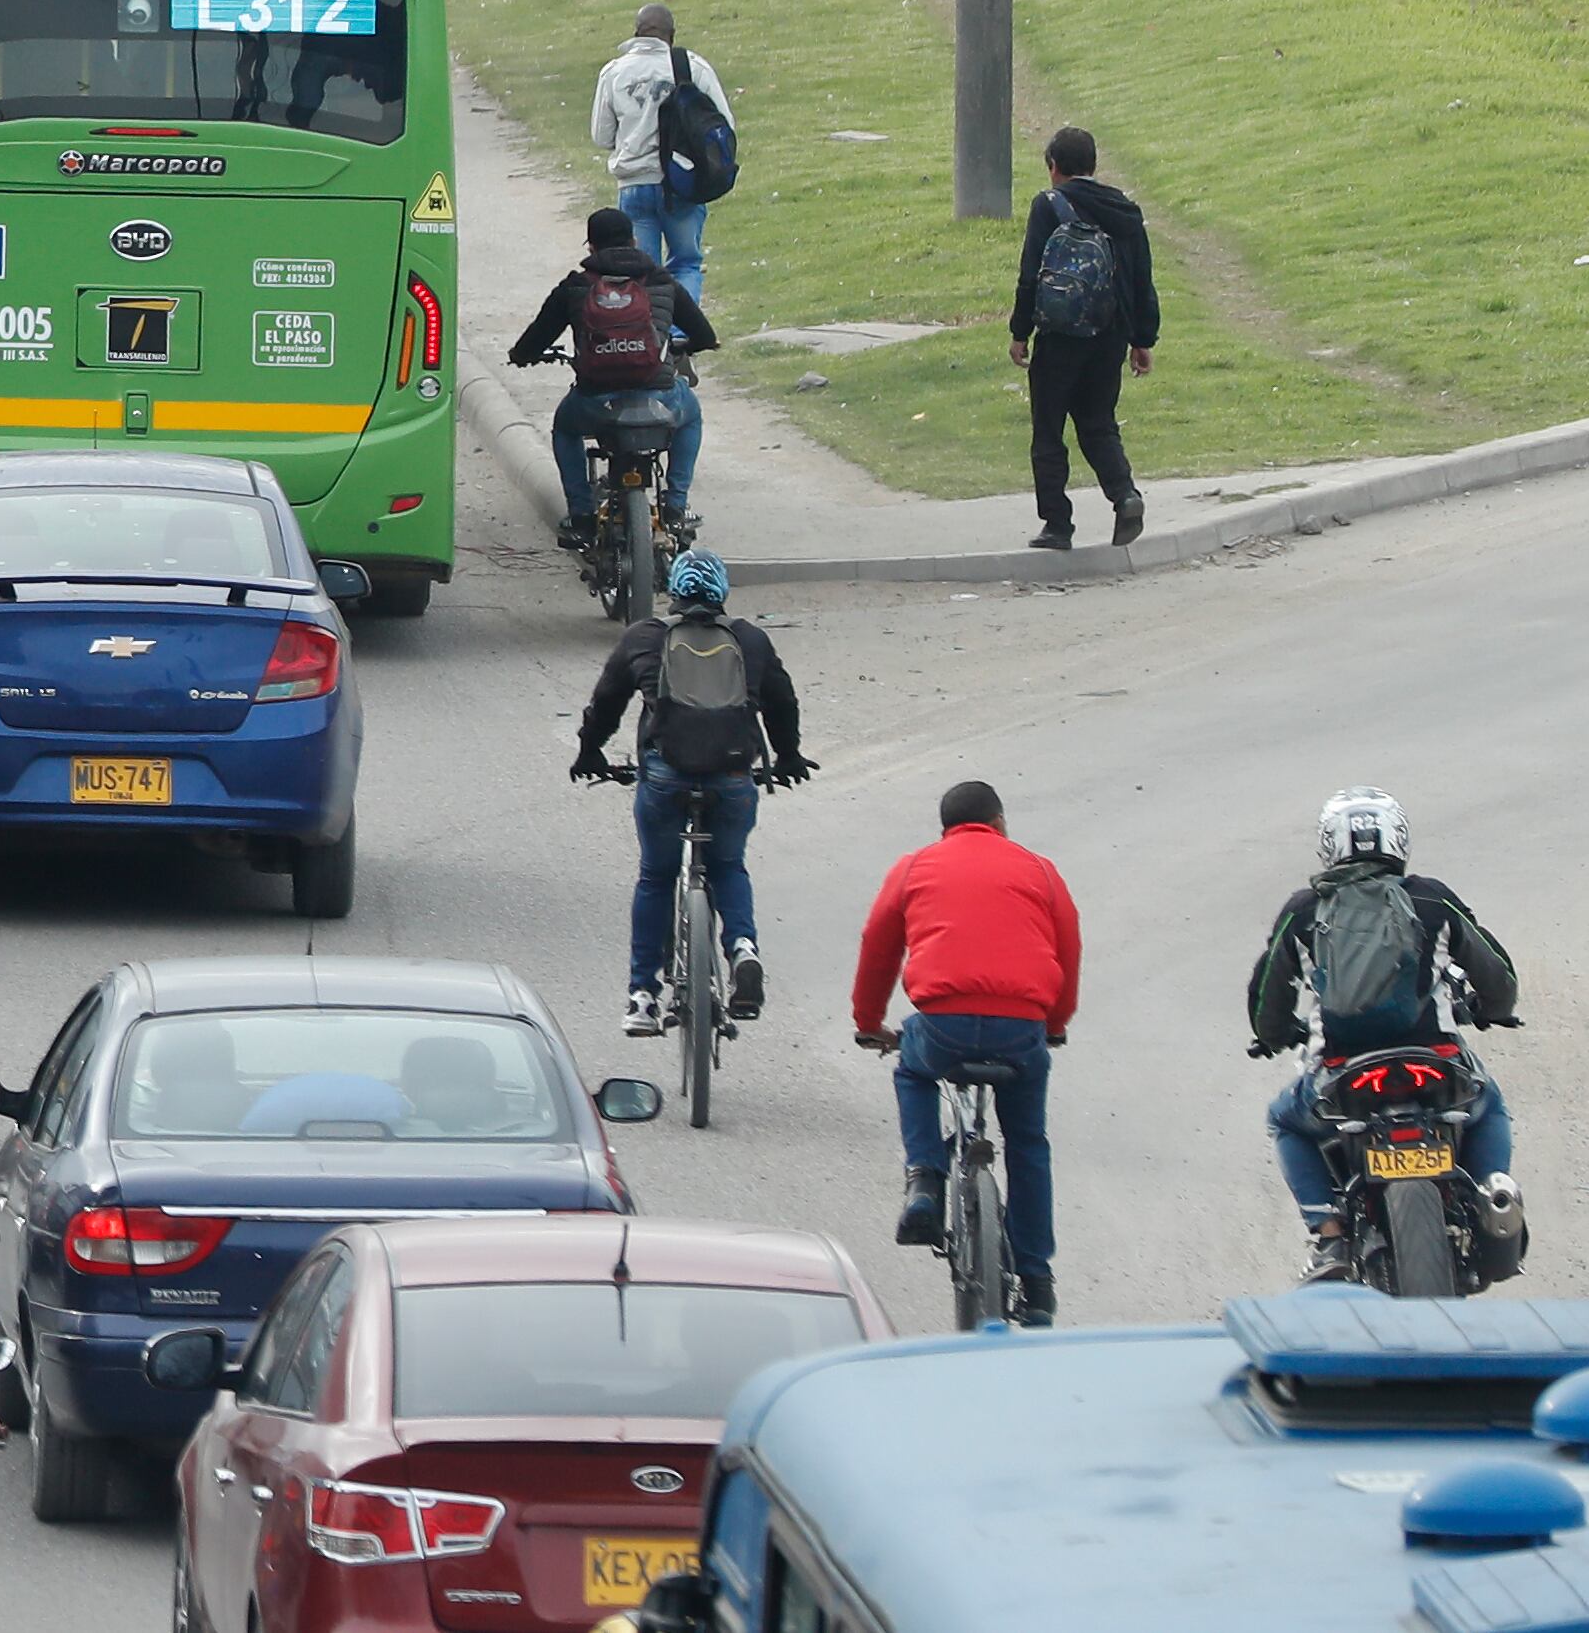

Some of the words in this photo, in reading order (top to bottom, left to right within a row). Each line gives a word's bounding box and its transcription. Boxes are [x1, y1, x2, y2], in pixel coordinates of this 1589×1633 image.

[88, 154, 224, 174] Marcopolo
[116, 231, 165, 250] BYD
[275, 314, 313, 329] CEDA
[264, 330, 282, 344] EL
[285, 330, 323, 344] PASO
[594, 337, 647, 354] adidas
[2, 348, 16, 361] III
[17, 349, 49, 362] S.A.S.
[108, 350, 168, 362] TRANSMILENIO
[0, 686, 35, 698] SAIL
